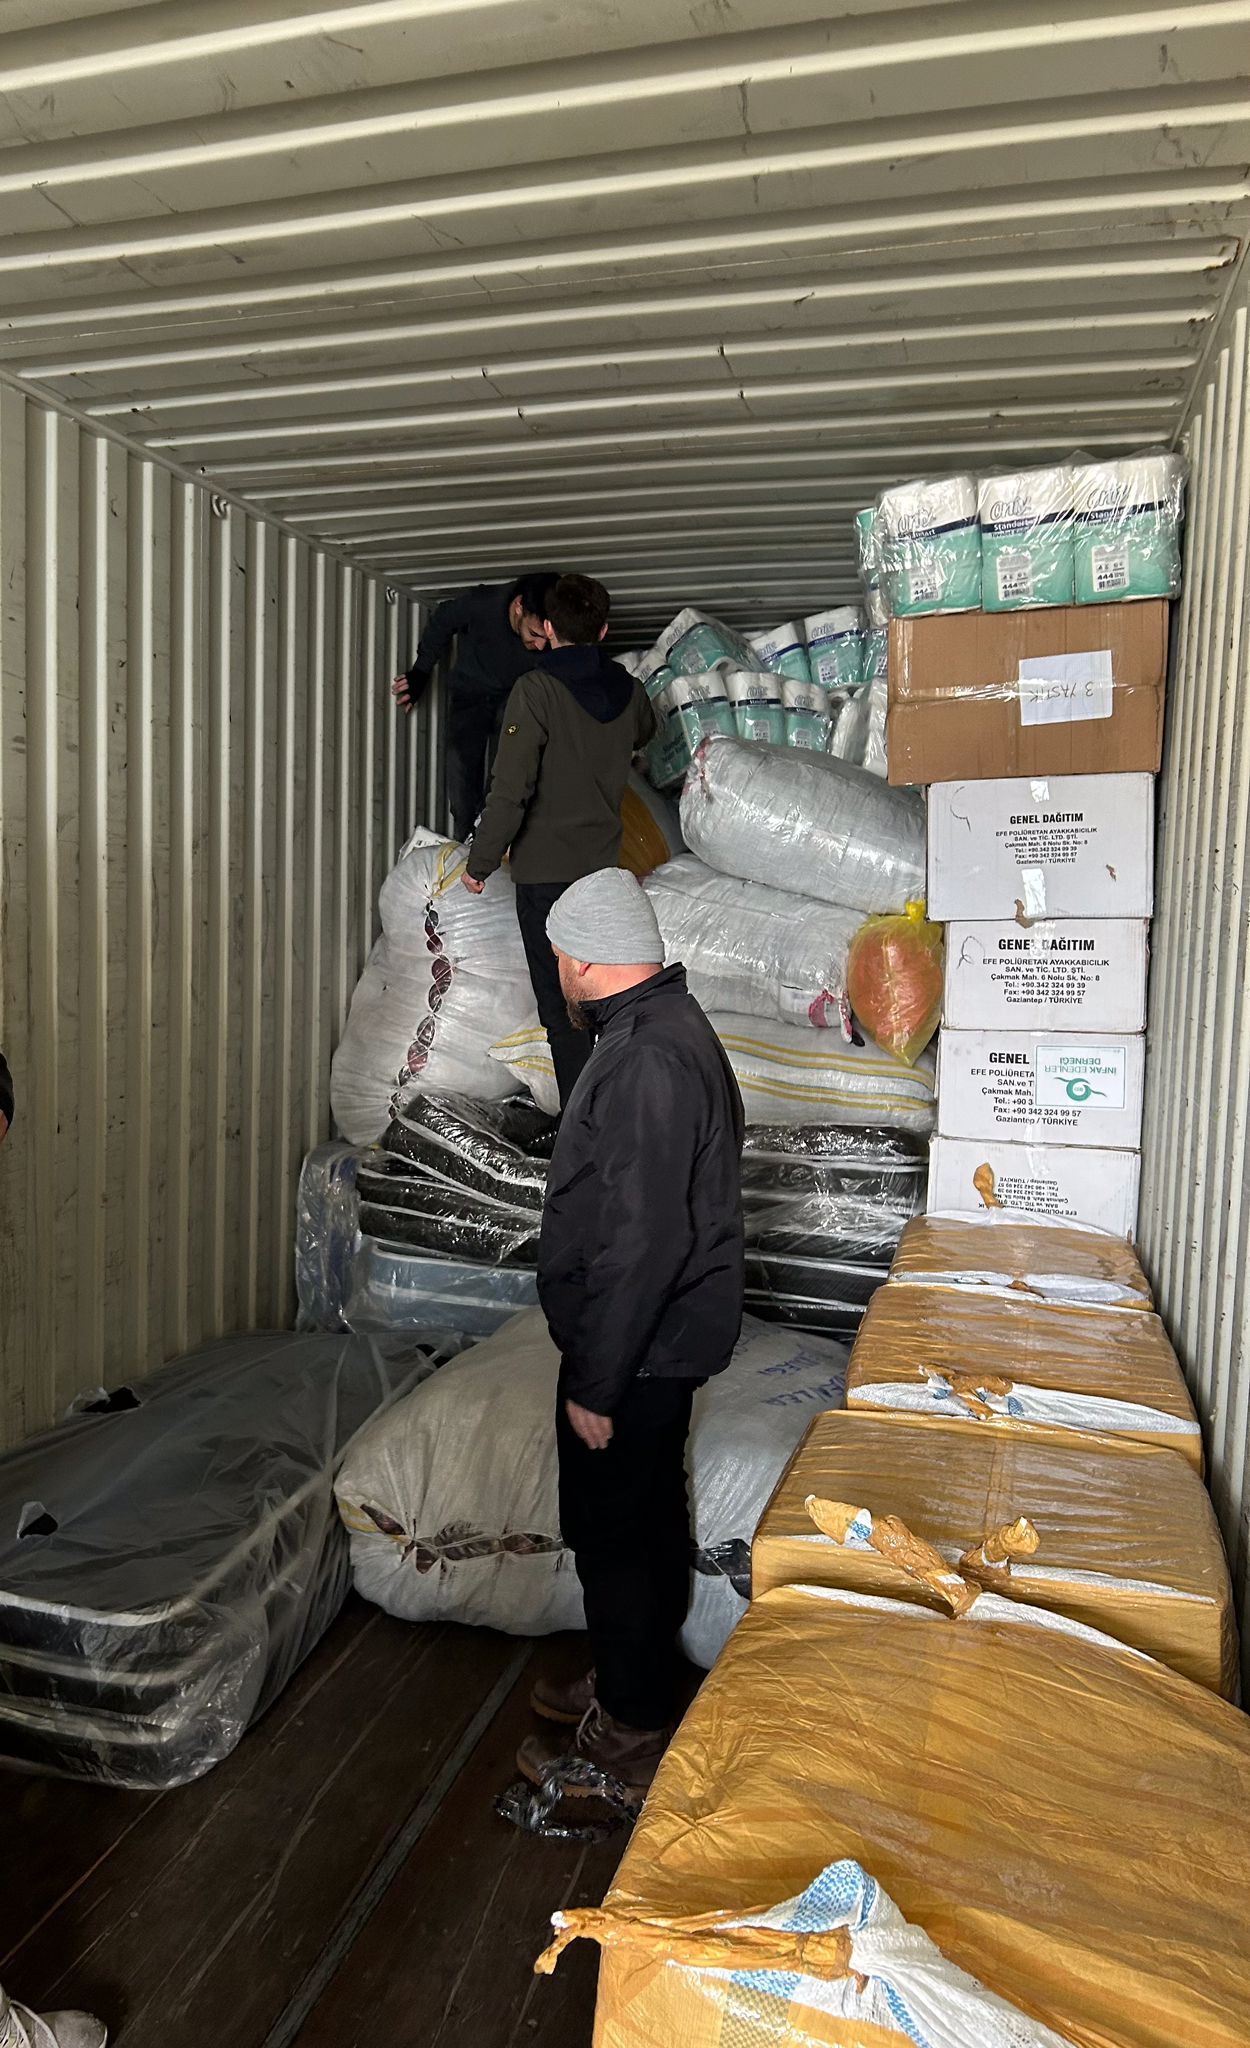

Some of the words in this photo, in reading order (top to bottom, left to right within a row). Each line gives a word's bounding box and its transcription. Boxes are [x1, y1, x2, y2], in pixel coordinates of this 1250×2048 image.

[1084, 681, 1094, 697] 3
[1010, 814, 1040, 824] GENEL
[1042, 812, 1084, 824] DAĞITIM
[1000, 957, 1048, 966] POLİÜRETAN
[1071, 966, 1085, 974] ŞTİ.
[1049, 996, 1082, 1004] TÜRKİYE
[989, 1052, 1030, 1065] GENEL
[989, 1068, 1035, 1078] POLİÜRETA
[1044, 1064, 1088, 1074] EDENLER
[1089, 1066, 1117, 1076] İNFAK
[981, 1087, 1013, 1096] Çakmak
[1014, 1088, 1034, 1096] Mah.
[993, 1106, 1010, 1114] Fax:
[996, 1115, 1034, 1125] Gaziantep
[1042, 1117, 1078, 1126] TÜRKİYE
